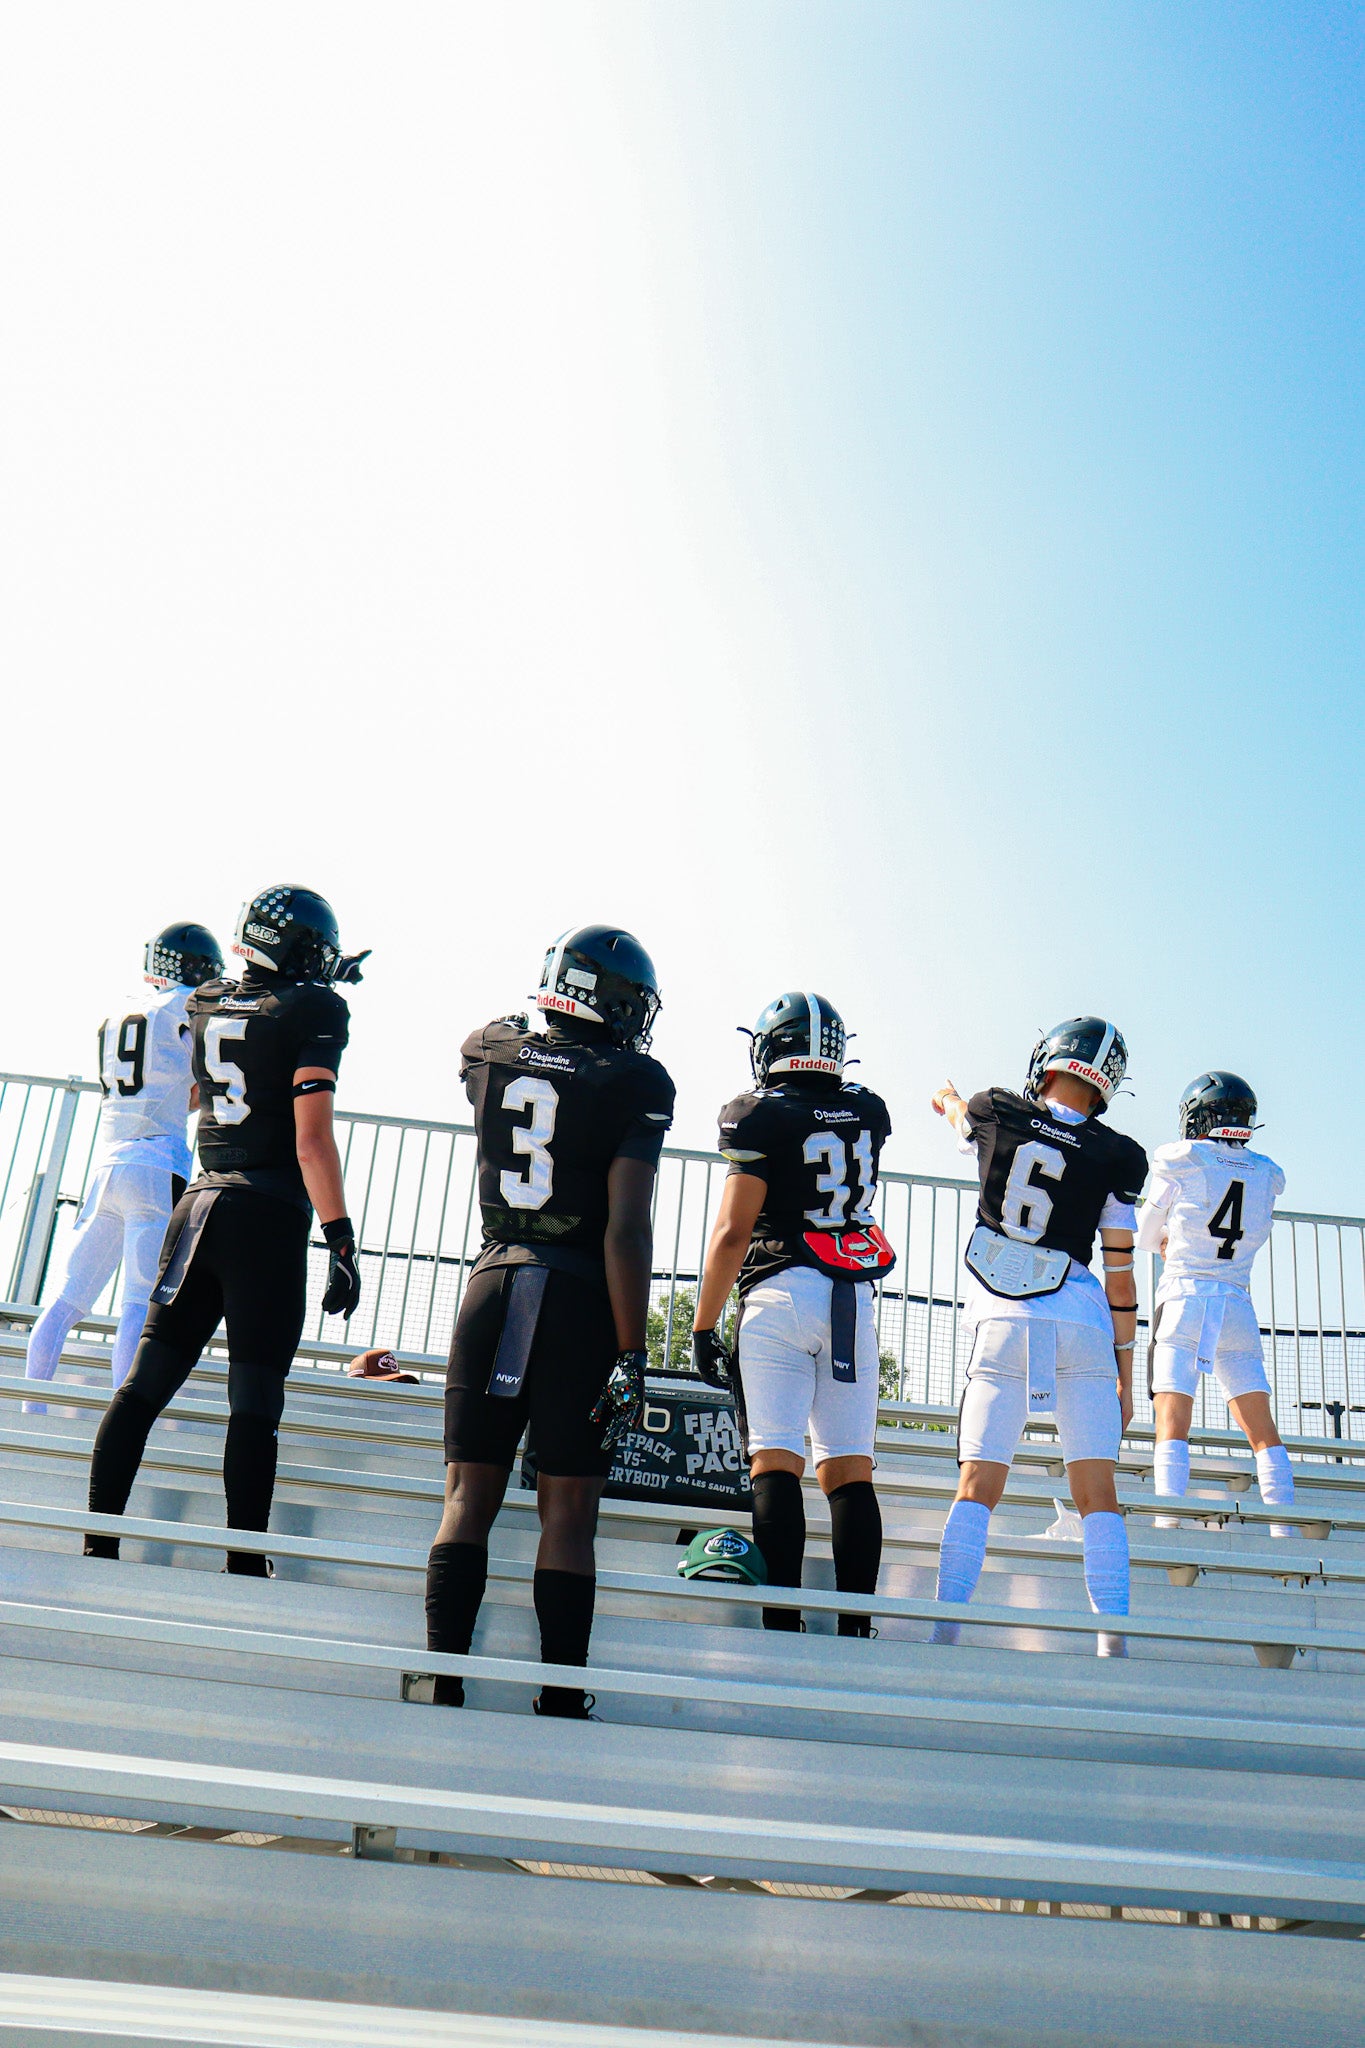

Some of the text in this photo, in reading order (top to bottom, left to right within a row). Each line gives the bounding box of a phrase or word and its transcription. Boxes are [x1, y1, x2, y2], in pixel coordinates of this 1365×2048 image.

[98, 1014, 147, 1098] 19
[531, 1051, 570, 1065] Desjardins
[789, 1058, 837, 1073] Riddell
[204, 1017, 251, 1126] 5
[1067, 1060, 1111, 1091] Riddell
[500, 1076, 559, 1210] 3
[1041, 1124, 1077, 1141] Desjardins
[801, 1130, 877, 1229] 31
[1000, 1140, 1066, 1244] 6
[1208, 1178, 1247, 1261] 4
[496, 1372, 521, 1385] NWY
[833, 1359, 850, 1370] NWY
[1031, 1391, 1051, 1401] NWY
[684, 1410, 739, 1435] FEA
[617, 1432, 677, 1464] LFPACK
[675, 1475, 690, 1485] ON
[691, 1478, 707, 1489] LES
